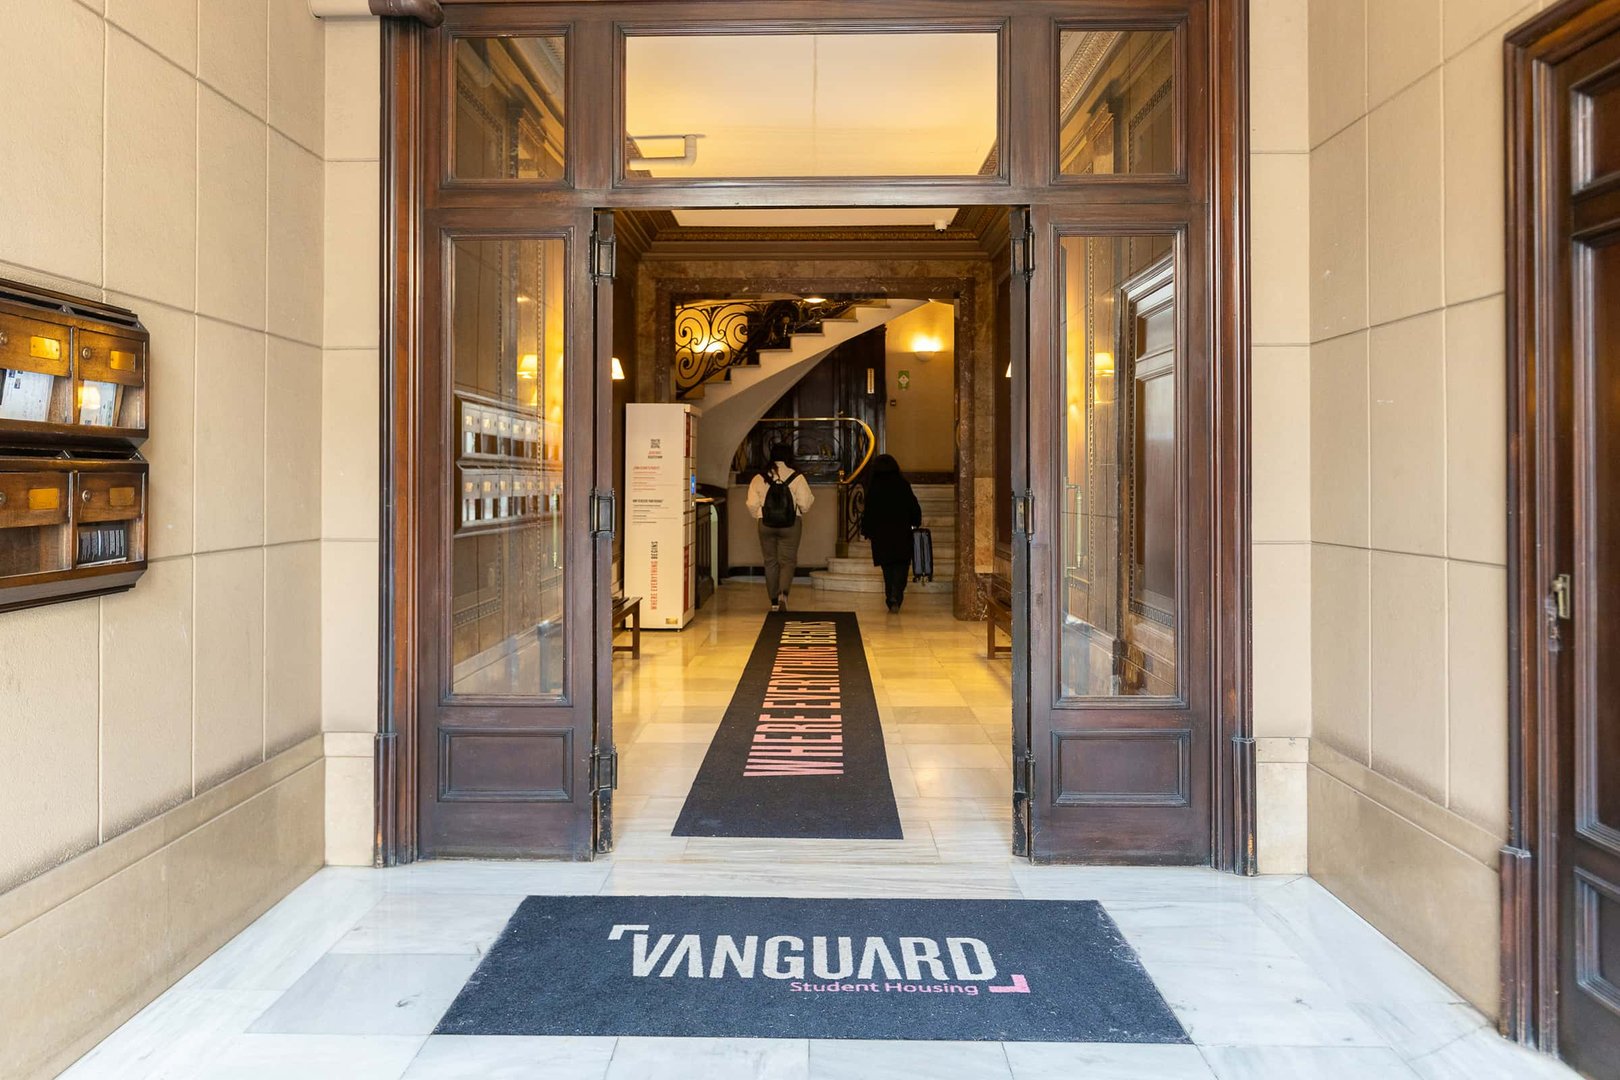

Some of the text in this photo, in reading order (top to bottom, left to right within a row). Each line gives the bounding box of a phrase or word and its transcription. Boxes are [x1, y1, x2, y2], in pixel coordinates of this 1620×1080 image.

[762, 646, 841, 708] EVERYTHING
[743, 714, 844, 776] WHERE
[632, 934, 997, 981] VANGUARD
[790, 981, 979, 995] Student Housing
